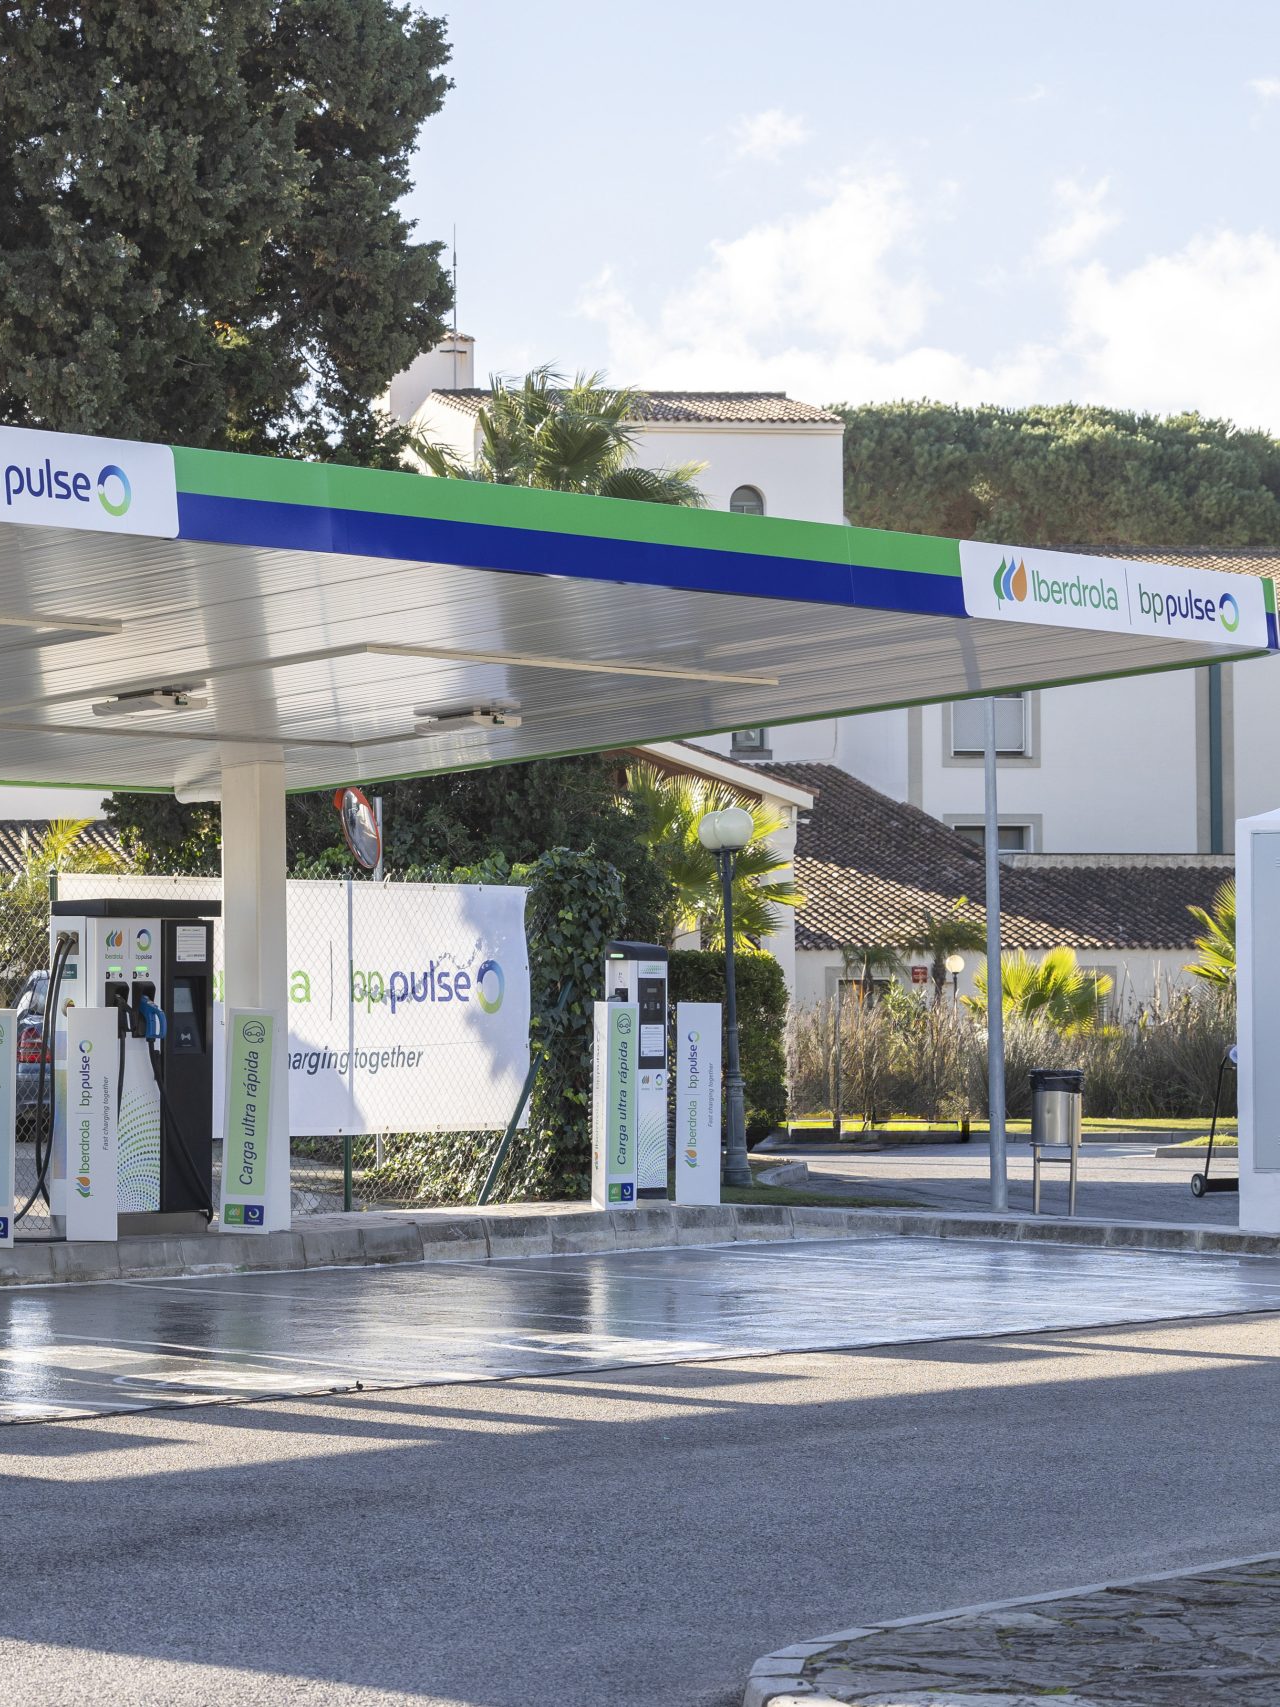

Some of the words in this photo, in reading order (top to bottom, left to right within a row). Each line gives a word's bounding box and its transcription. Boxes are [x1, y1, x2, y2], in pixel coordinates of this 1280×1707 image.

[1031, 569, 1119, 611] Iberdrola
[245, 1050, 263, 1097] rápida
[287, 1046, 350, 1075] arging
[354, 1045, 424, 1075] together
[619, 1041, 629, 1085] rápida
[103, 1076, 111, 1104] together
[618, 1090, 628, 1121] ultra
[103, 1105, 111, 1133] charging
[242, 1102, 257, 1136] ultra
[687, 1100, 698, 1148] Iberdrola
[78, 1120, 90, 1175] Iberdrola
[239, 1137, 258, 1186] Carga
[617, 1125, 629, 1166] Carga
